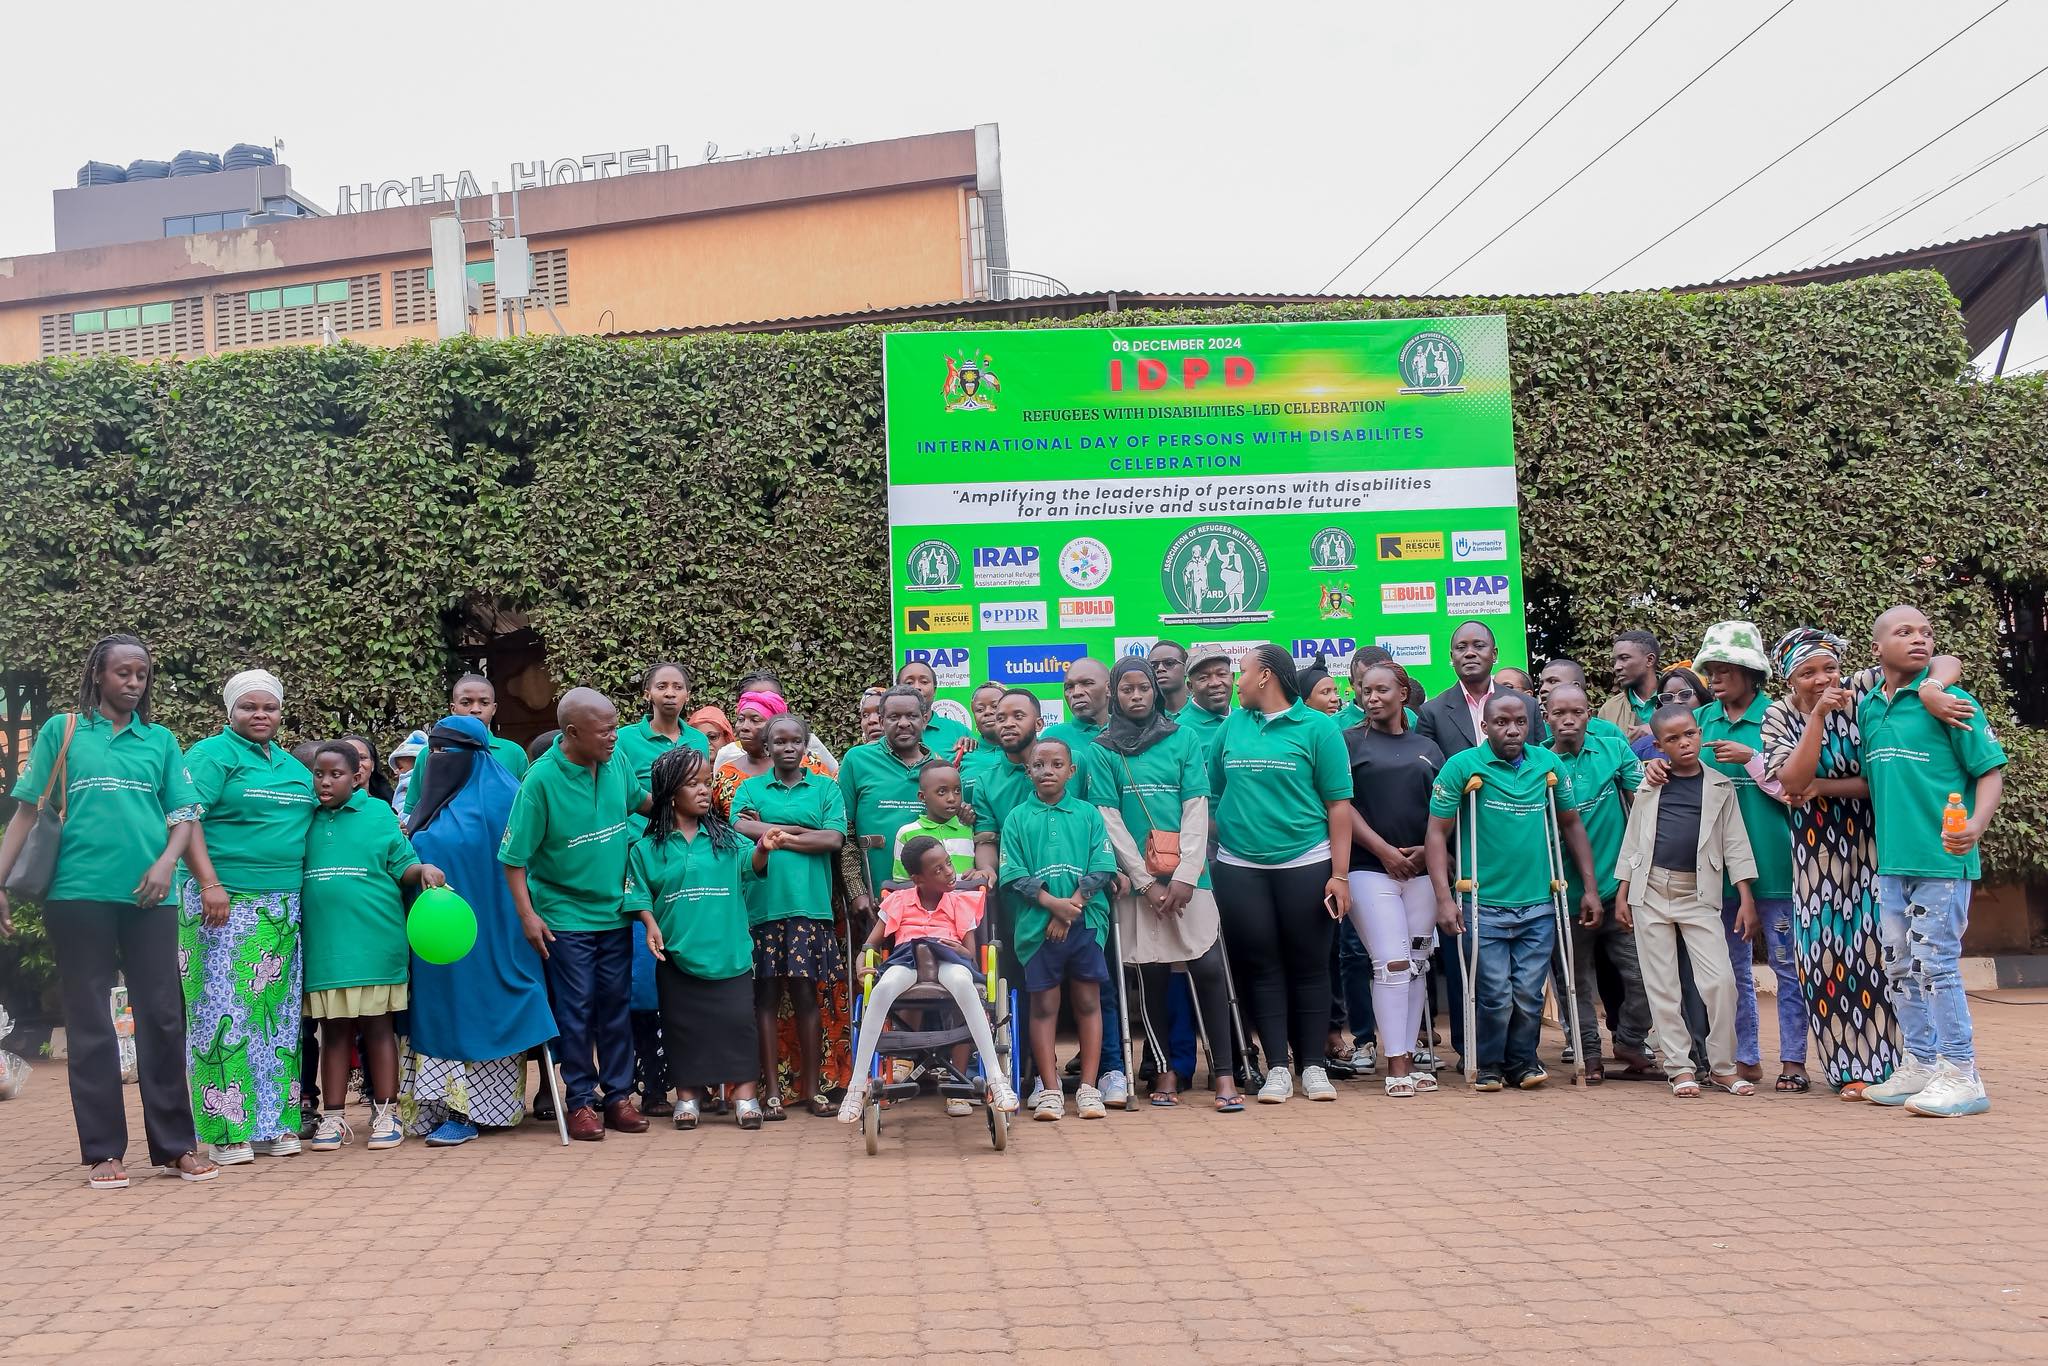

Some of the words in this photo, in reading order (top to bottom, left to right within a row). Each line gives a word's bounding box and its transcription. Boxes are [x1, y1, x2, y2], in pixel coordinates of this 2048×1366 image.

[1112, 340, 1129, 352] 03
[1133, 339, 1205, 351] DECEMBER
[1208, 338, 1242, 350] 2024
[1023, 408, 1100, 422] REFUGEES
[1103, 407, 1145, 420] WITH
[1284, 400, 1386, 415] CELEBRATION
[917, 437, 1072, 453] INTERNATIONAL
[1080, 435, 1119, 449] DAY
[1127, 435, 1150, 448] OF
[1158, 432, 1245, 447] PERSONS
[1253, 430, 1302, 445] WITH
[1310, 427, 1424, 443] DISABILITES
[1110, 455, 1241, 471] CELEBRATION
[953, 488, 1056, 506] "Amplifying
[1062, 488, 1090, 500] the
[1096, 484, 1189, 501] leadership
[1195, 483, 1214, 497] of
[1217, 482, 1286, 499] persons
[1292, 480, 1329, 494] with
[1335, 477, 1432, 493] disabilities
[1018, 504, 1042, 518] for
[1047, 505, 1069, 516] an
[1075, 500, 1154, 516] inclusive
[1160, 499, 1193, 513] and
[1199, 496, 1302, 512] sustainable
[1308, 494, 1370, 510] future"
[1163, 533, 1189, 573] ASSOCIATION
[1188, 528, 1198, 538] OF
[1197, 524, 1232, 533] REFUGEES
[1232, 529, 1248, 542] WITH
[1247, 539, 1267, 573] DISABILITY
[1405, 542, 1440, 550] RESCUE
[974, 547, 1039, 567] IRAP
[975, 571, 1013, 579] International
[1015, 571, 1040, 579] Refugee
[975, 579, 1007, 587] Assistance
[1446, 576, 1509, 596] IRAP
[1206, 590, 1224, 599] ARD
[934, 615, 969, 623] RESCUE
[994, 608, 1039, 621] PPDR
[1480, 607, 1501, 615] Project
[1292, 638, 1356, 658] IRAP
